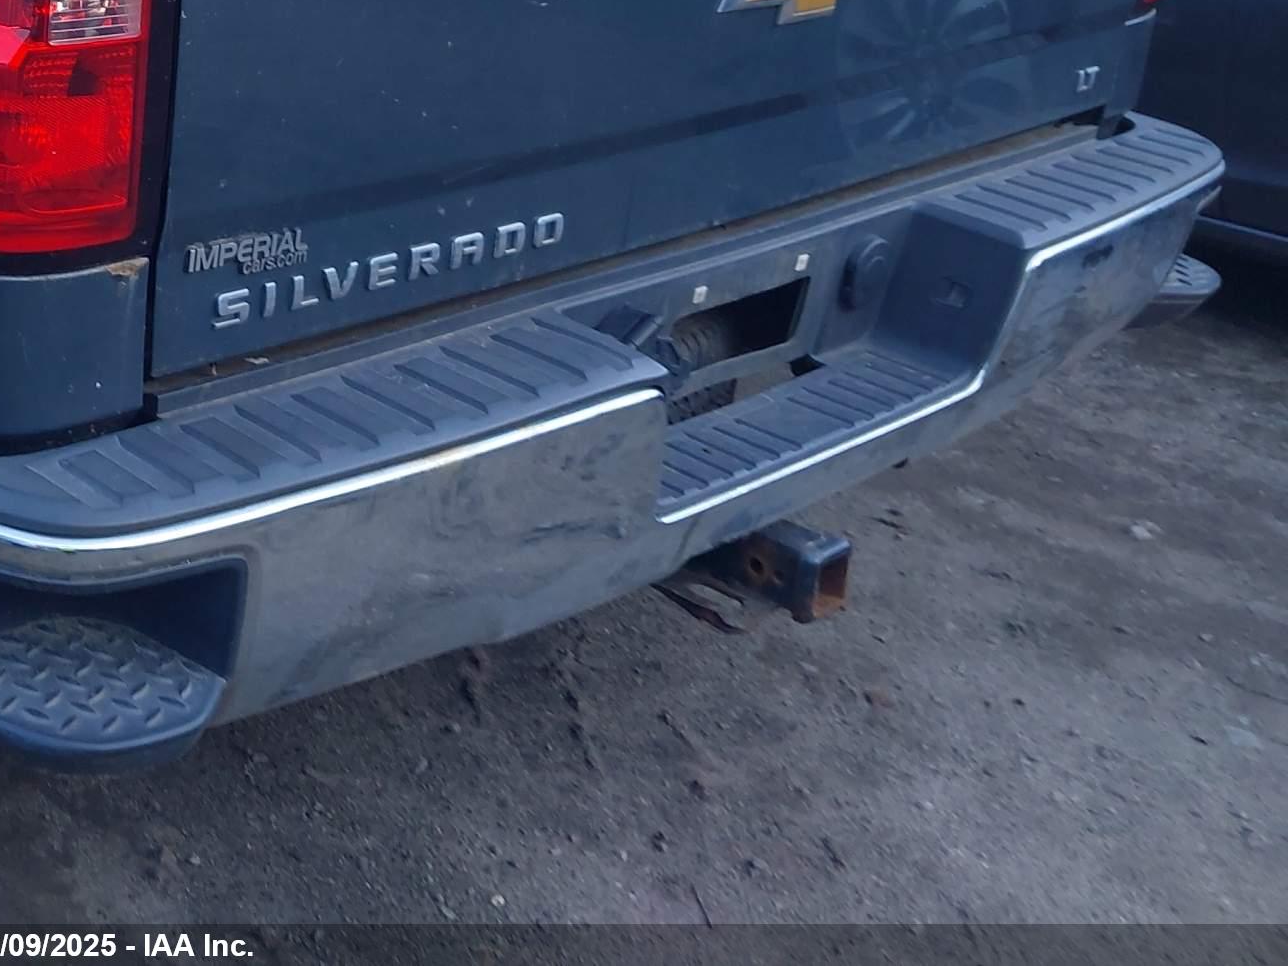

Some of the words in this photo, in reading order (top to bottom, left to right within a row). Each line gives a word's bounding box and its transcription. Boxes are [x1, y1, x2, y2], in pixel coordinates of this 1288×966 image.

[1075, 65, 1101, 93] LT
[185, 227, 309, 273] IMPERIAL
[213, 211, 565, 331] SILVERADO
